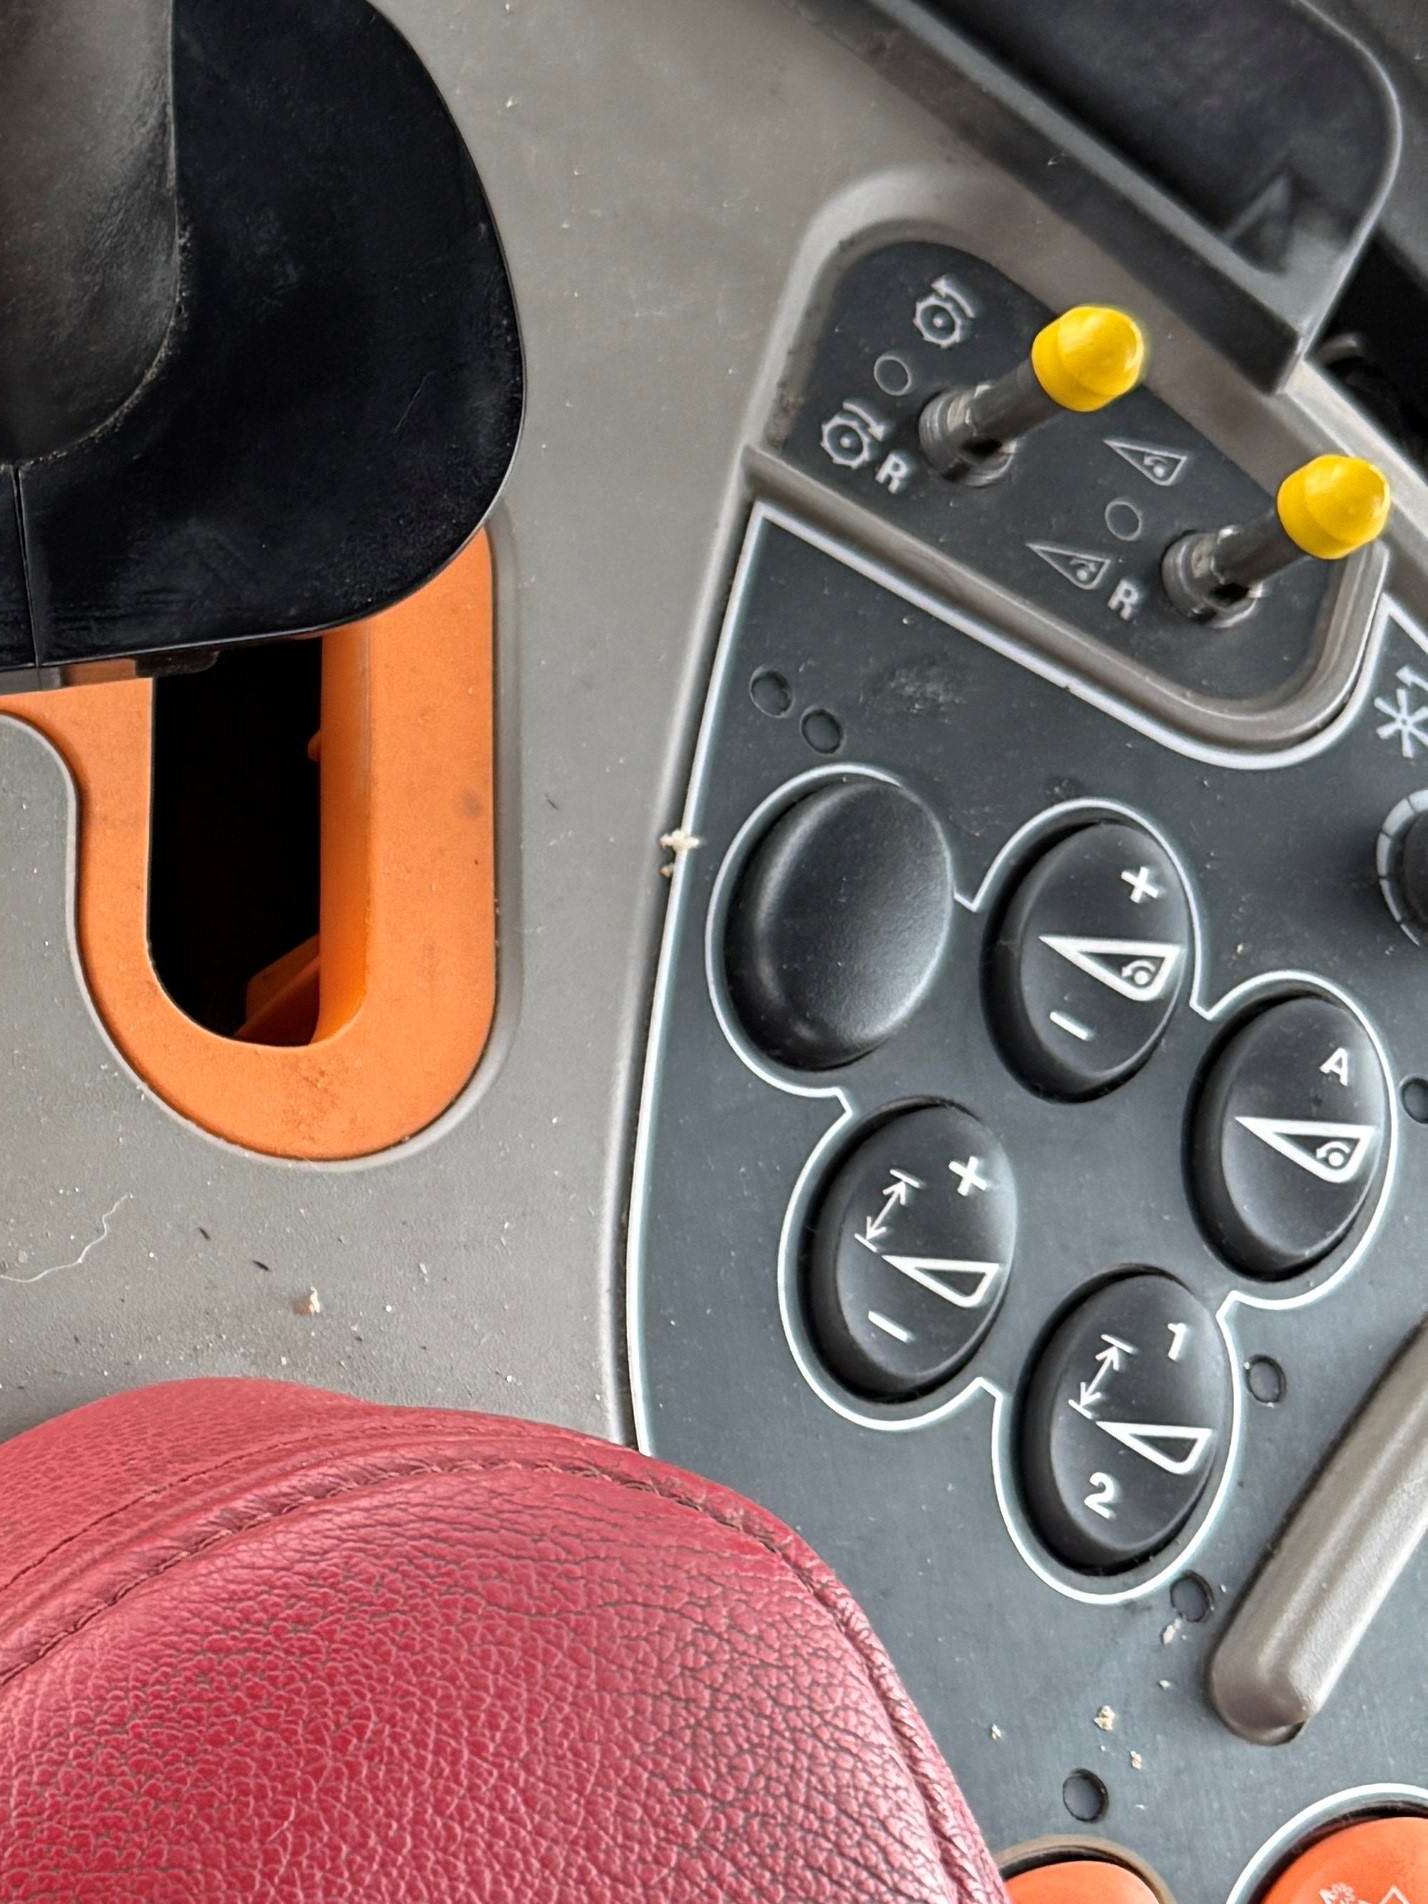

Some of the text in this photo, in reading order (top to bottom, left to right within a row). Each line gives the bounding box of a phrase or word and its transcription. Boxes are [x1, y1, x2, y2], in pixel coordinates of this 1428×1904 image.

[875, 450, 909, 494] R
[1108, 578, 1141, 621] R
[1319, 1047, 1348, 1086] A
[1167, 1323, 1187, 1361] 1
[1084, 1472, 1116, 1519] 2
